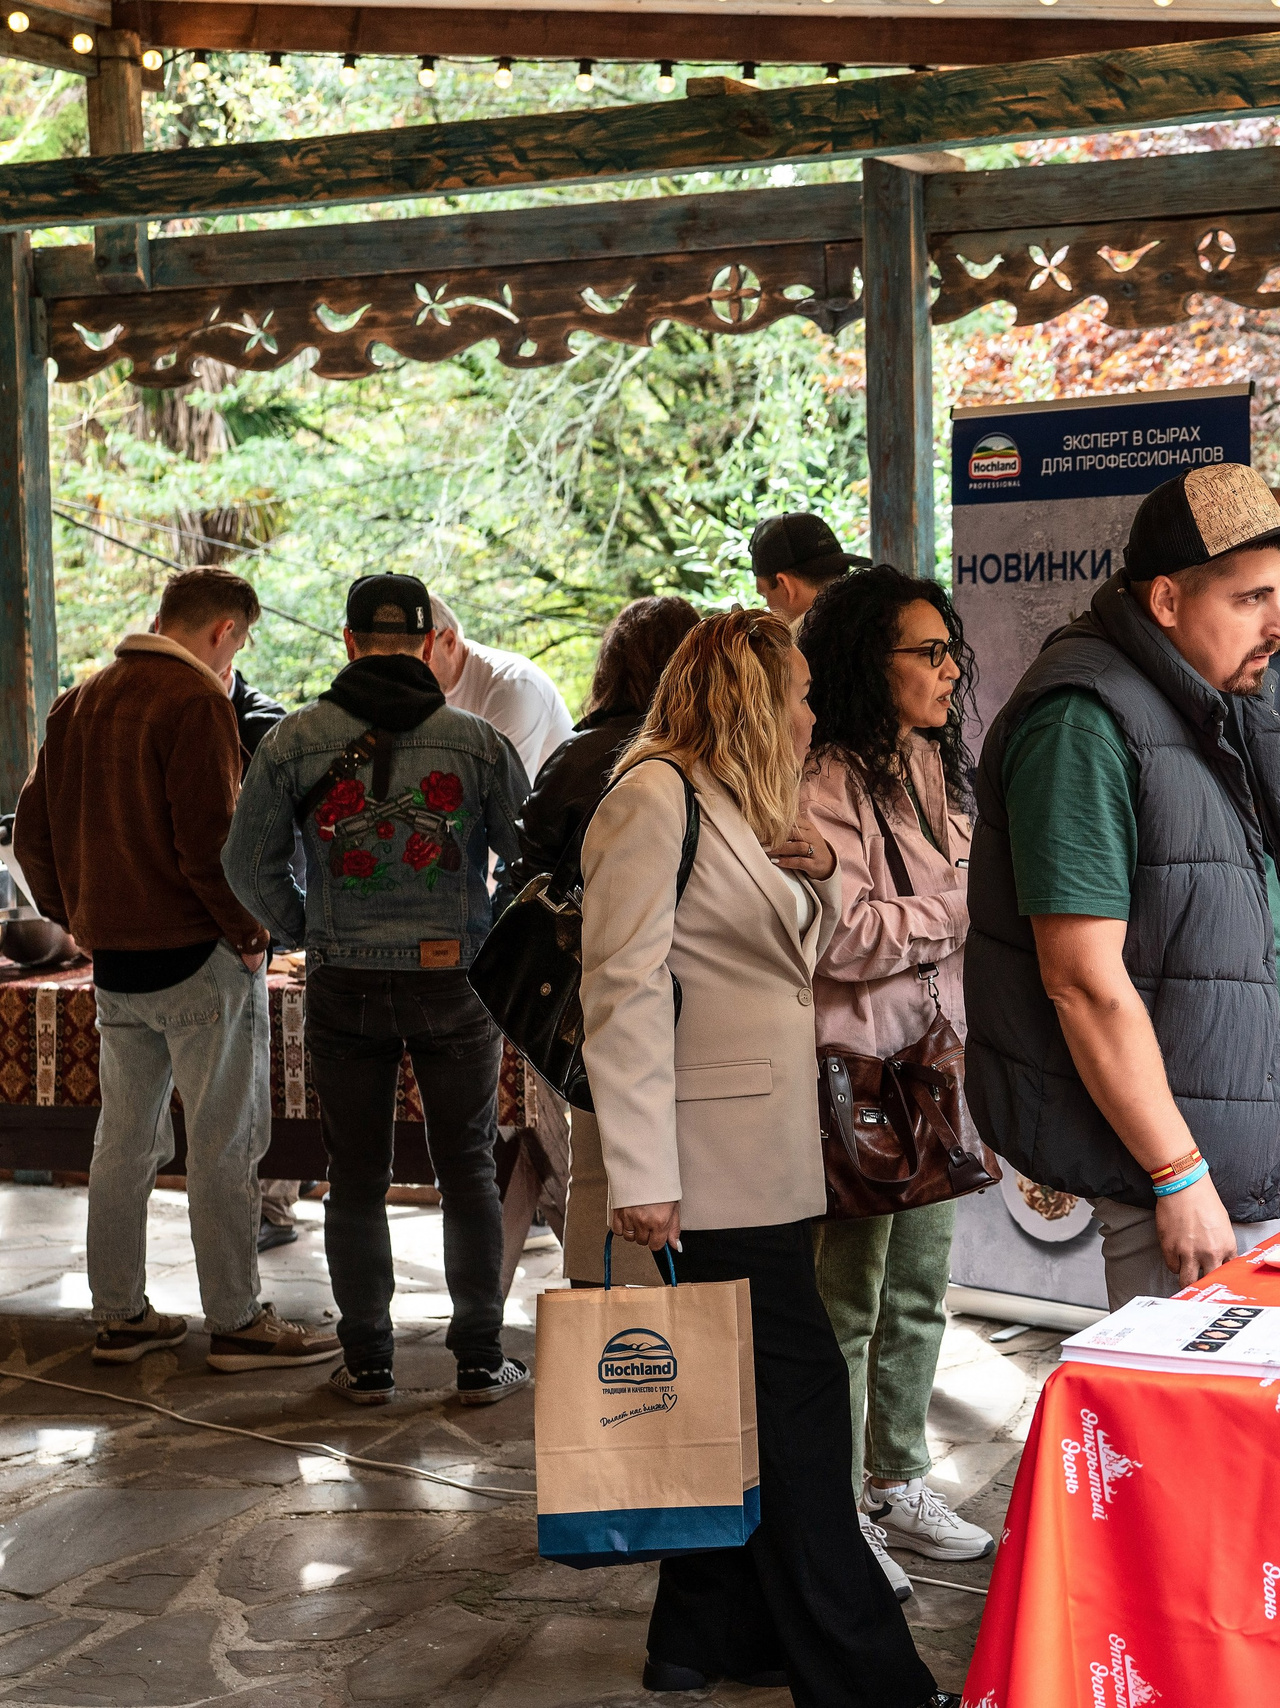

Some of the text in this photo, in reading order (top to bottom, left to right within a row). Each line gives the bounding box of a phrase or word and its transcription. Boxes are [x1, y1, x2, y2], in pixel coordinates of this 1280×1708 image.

[1063, 426, 1201, 450] ЭКСПЕРТ В СЫРАХ
[973, 460, 1017, 473] Hochland
[1041, 446, 1224, 476] ДЛЯ ПРОФЕССИОНАЛОВ
[968, 480, 1021, 489] PROFESSIONAL
[958, 549, 1112, 584] НОВИНКИ
[604, 1361, 671, 1377] Hochland
[602, 1387, 627, 1395] ТРАДИЦИИ
[632, 1386, 654, 1394] КАЧЕСТВО
[600, 1410, 628, 1427] Делает
[1061, 1438, 1081, 1494] Огонь
[1080, 1408, 1108, 1521] Открытый
[1089, 1661, 1109, 1708] Огон
